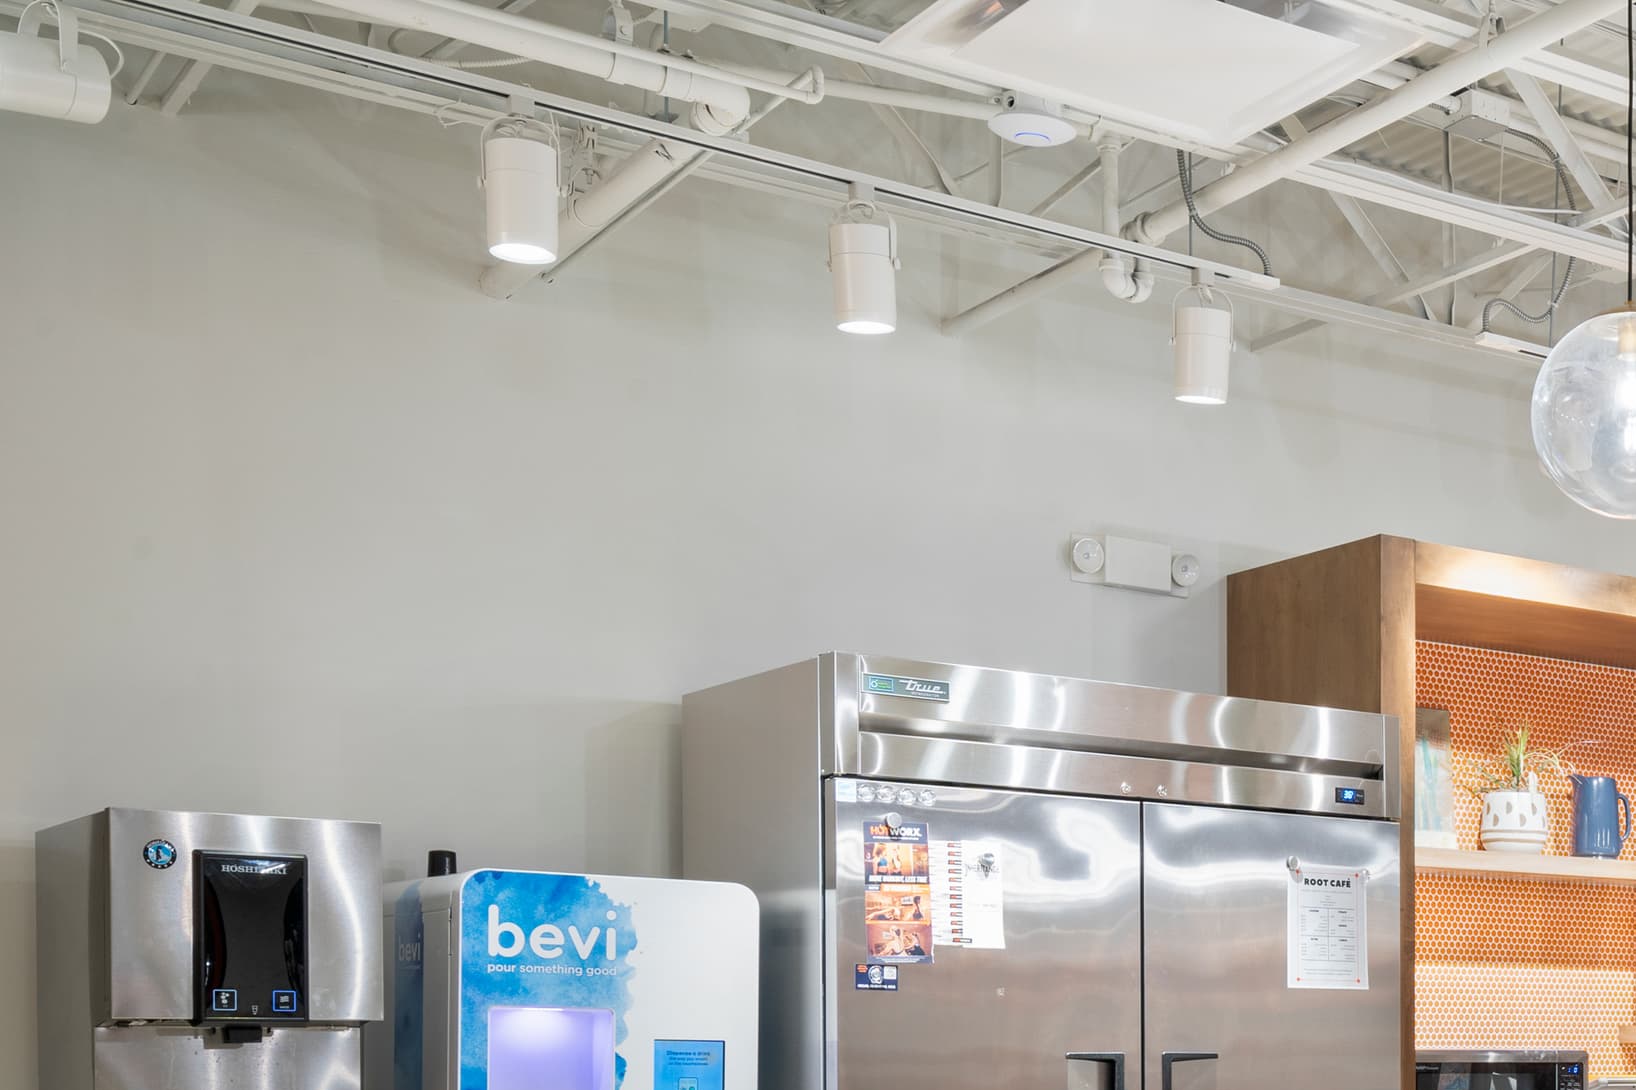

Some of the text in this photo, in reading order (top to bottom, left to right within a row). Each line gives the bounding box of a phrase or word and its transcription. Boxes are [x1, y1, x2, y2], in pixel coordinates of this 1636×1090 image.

[221, 864, 287, 875] HOSHIAKI
[1304, 878, 1351, 888] ROOT CAFÉ
[487, 904, 617, 960] bevi
[487, 963, 617, 977] pour something good
